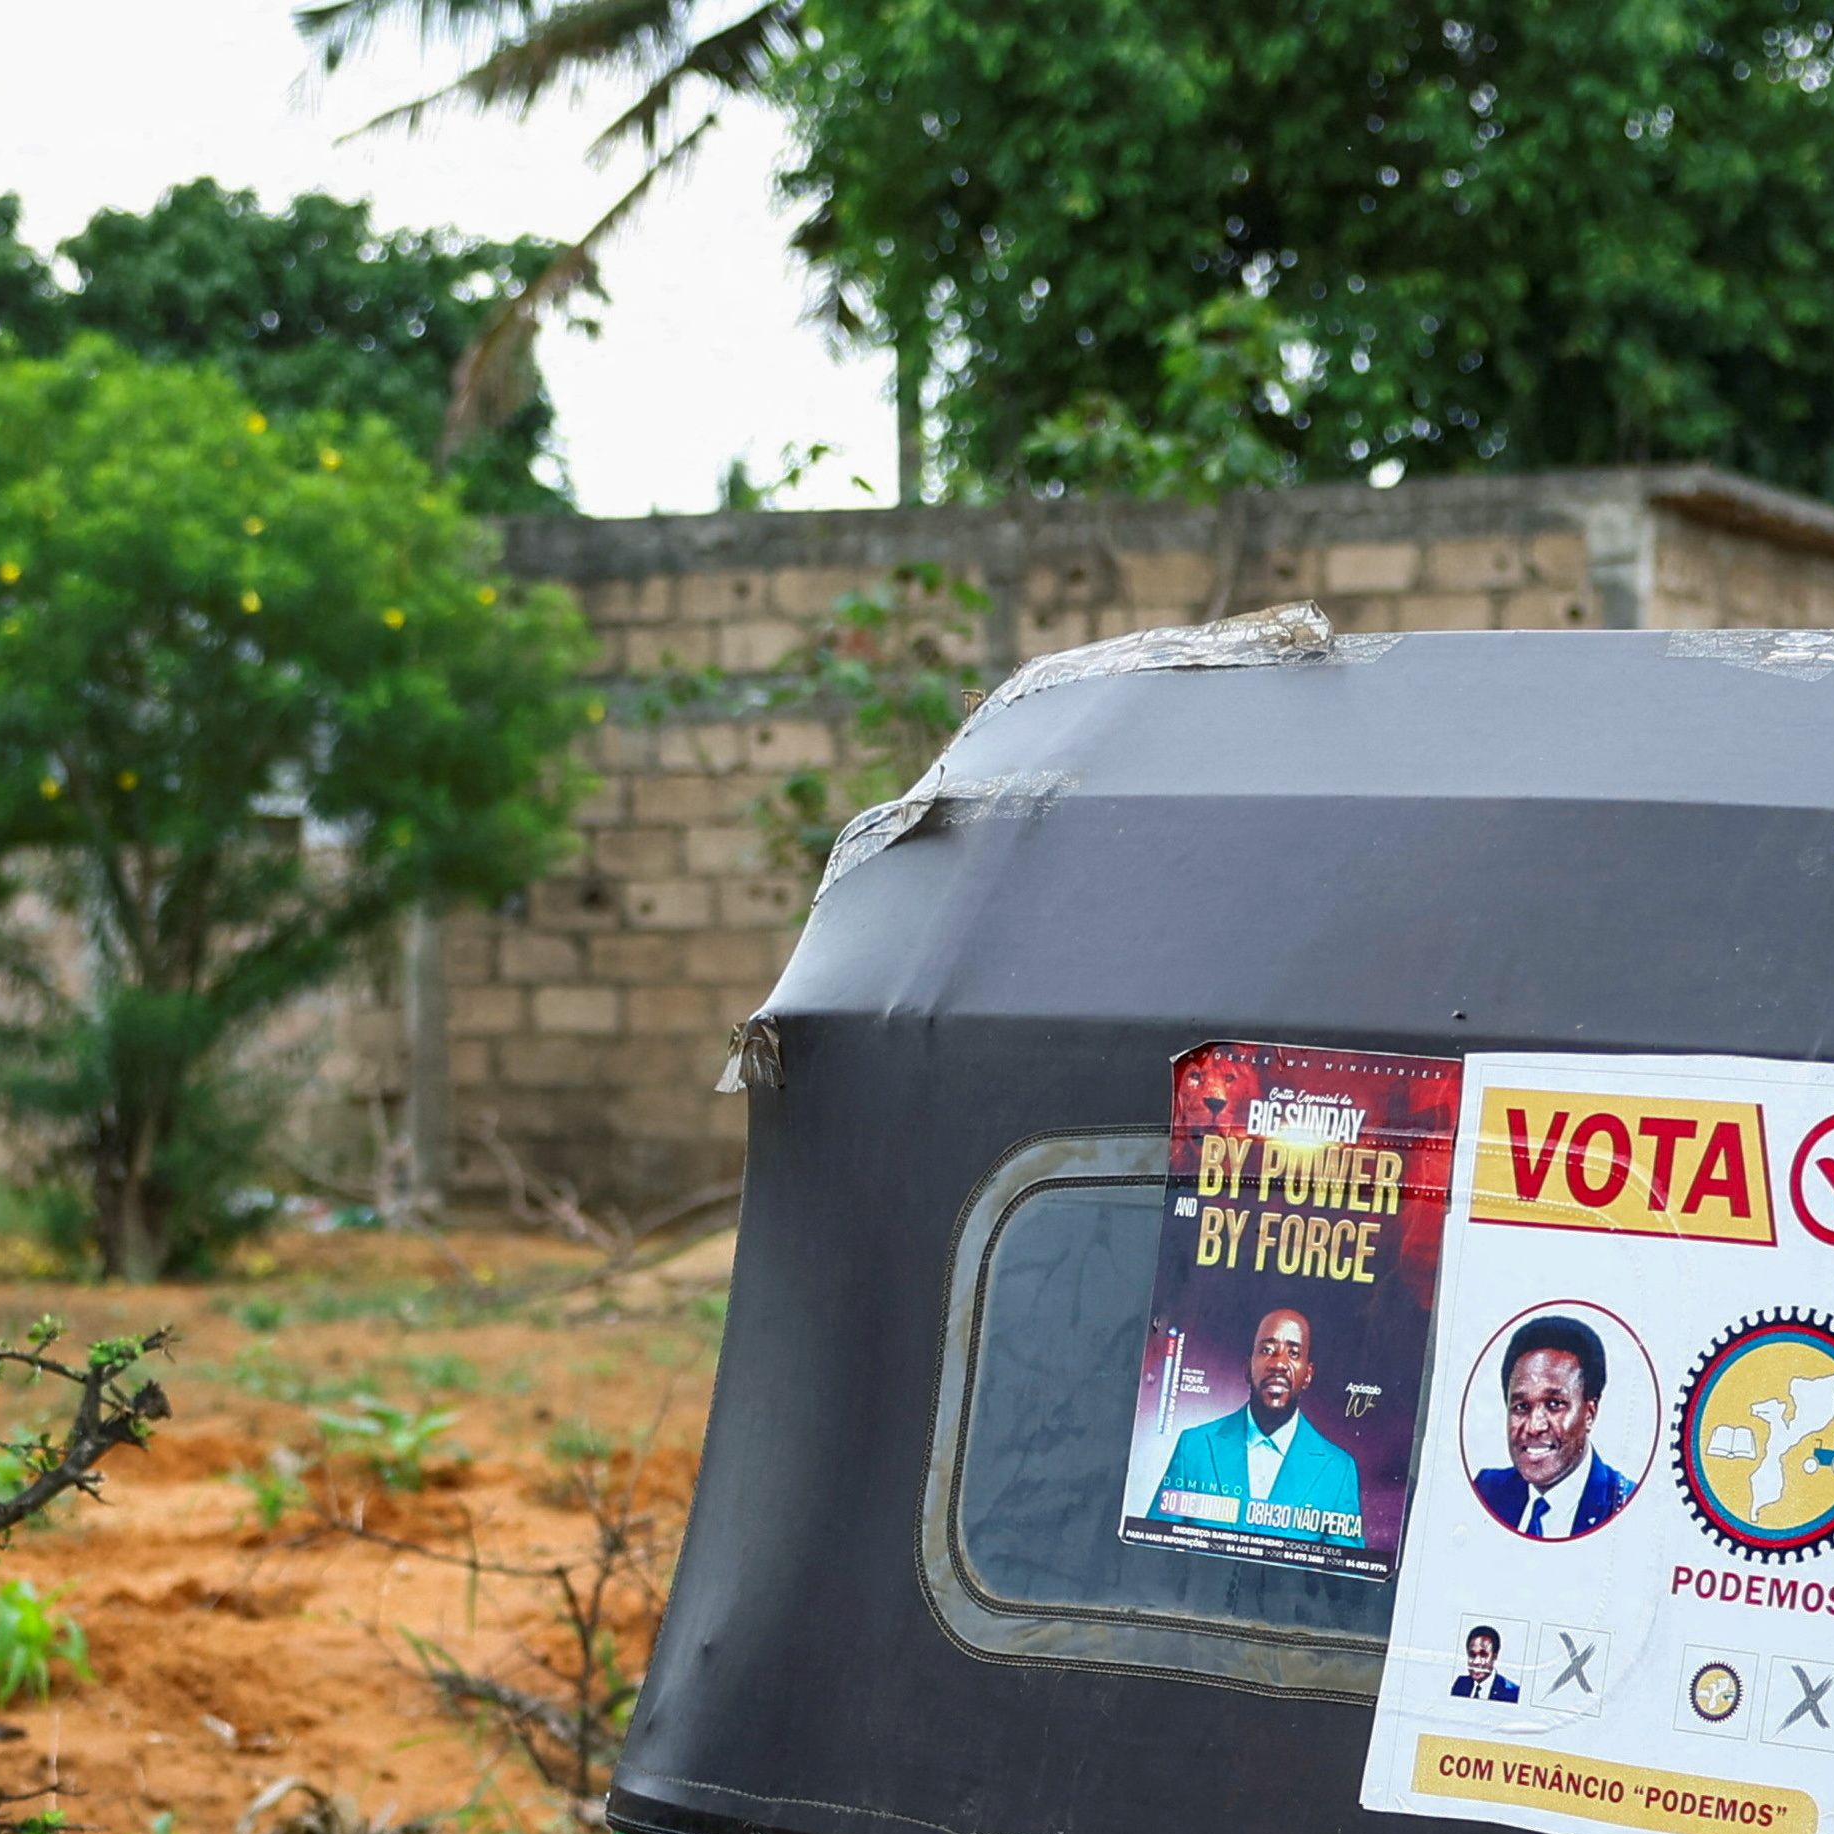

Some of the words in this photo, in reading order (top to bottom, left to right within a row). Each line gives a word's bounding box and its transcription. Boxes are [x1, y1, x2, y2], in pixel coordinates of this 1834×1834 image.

[1324, 1063, 1442, 1080] MINISTRIES
[1296, 1089, 1339, 1106] Especial
[1246, 1099, 1283, 1138] BIG
[1284, 1102, 1366, 1145] SUNDAY
[1197, 1134, 1253, 1200] BY
[1257, 1138, 1403, 1216] POWER
[1505, 1107, 1752, 1220] VOTA
[1174, 1196, 1198, 1218] AND
[1196, 1207, 1250, 1269] BY
[1254, 1212, 1382, 1284] FORCE
[1163, 1475, 1244, 1496] DOMINGO
[1160, 1491, 1177, 1513] 30
[1180, 1493, 1196, 1514] DE
[1245, 1500, 1291, 1529] 08H30
[1293, 1503, 1320, 1533] NÃO
[1320, 1512, 1363, 1538] PERCA
[1438, 1753, 1495, 1783] COM
[1502, 1761, 1626, 1805] VENÂNCIO
